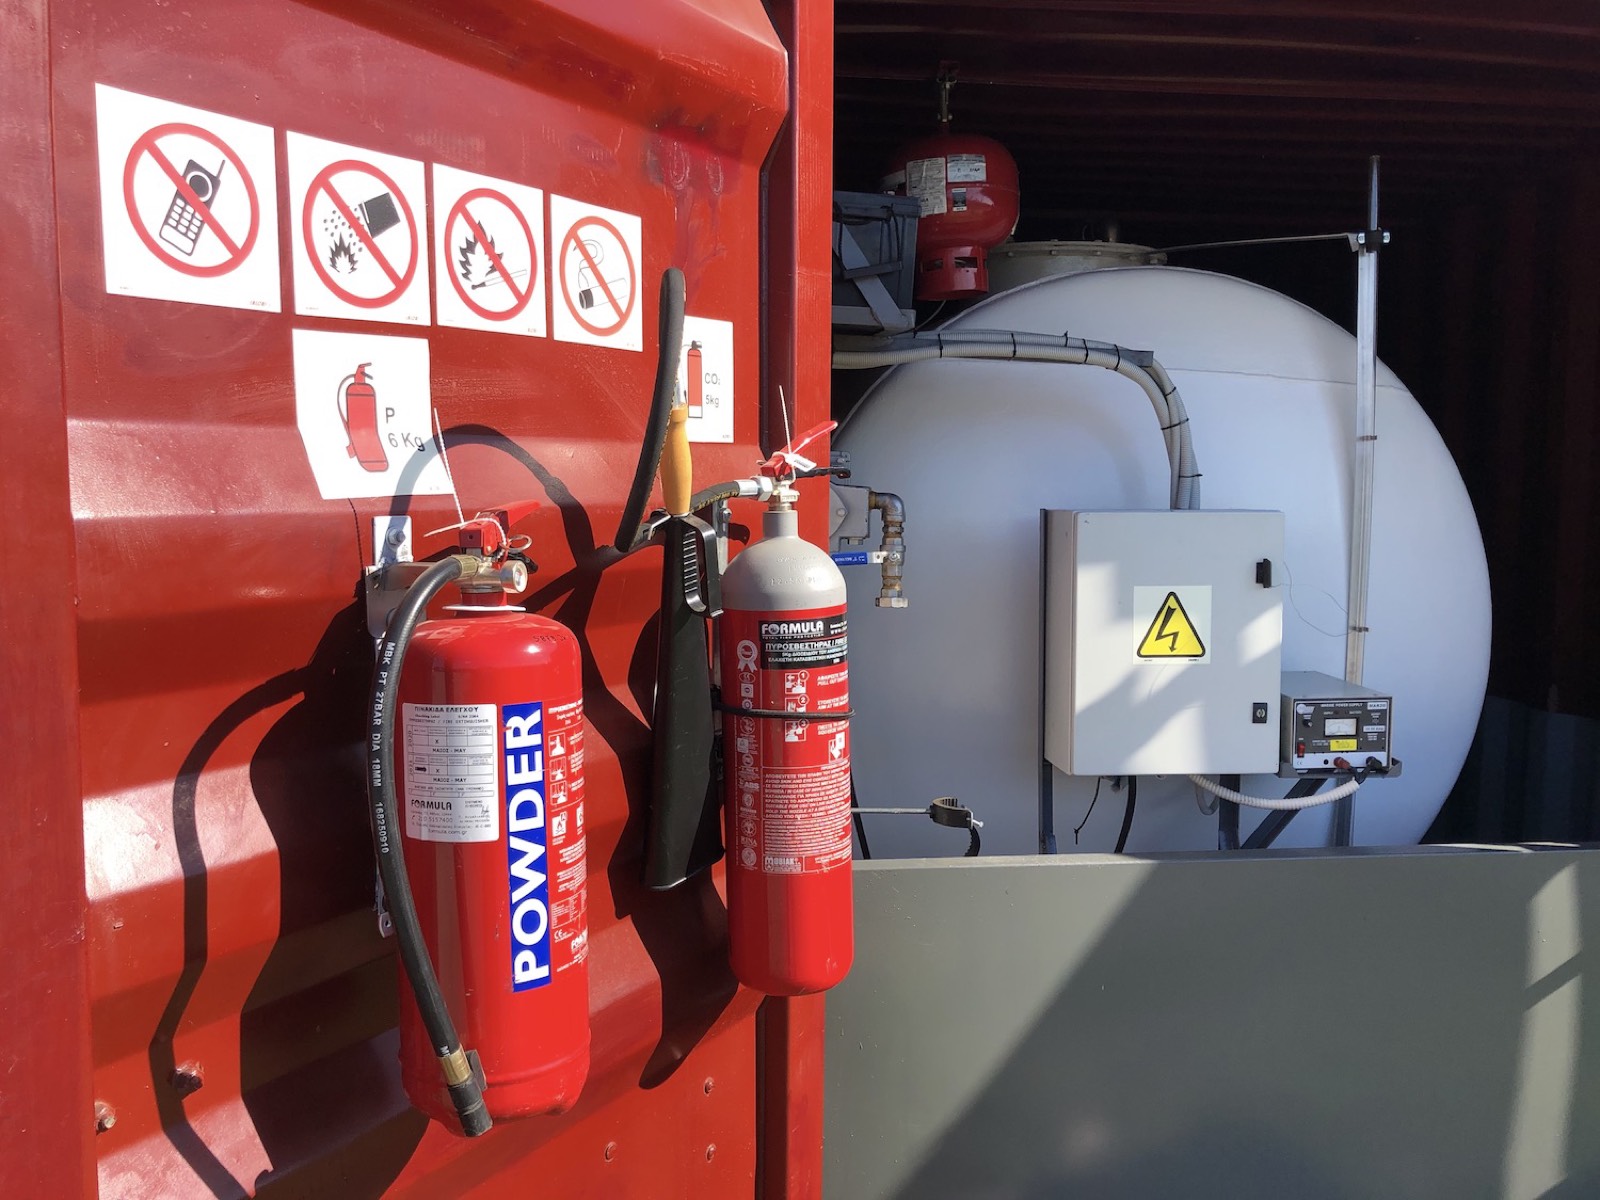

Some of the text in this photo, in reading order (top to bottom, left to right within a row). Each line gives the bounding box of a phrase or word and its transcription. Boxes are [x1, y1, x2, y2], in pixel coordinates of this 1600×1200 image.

[705, 394, 720, 409] 5kg
[385, 406, 396, 424] P
[401, 432, 426, 452] Kg
[761, 621, 824, 635] FORMULA
[382, 641, 397, 666] MBK
[378, 671, 388, 686] PT
[372, 691, 385, 727] 27BAR
[369, 733, 381, 752] DIA
[411, 799, 452, 811] FORMULA
[505, 708, 550, 984] POWDER
